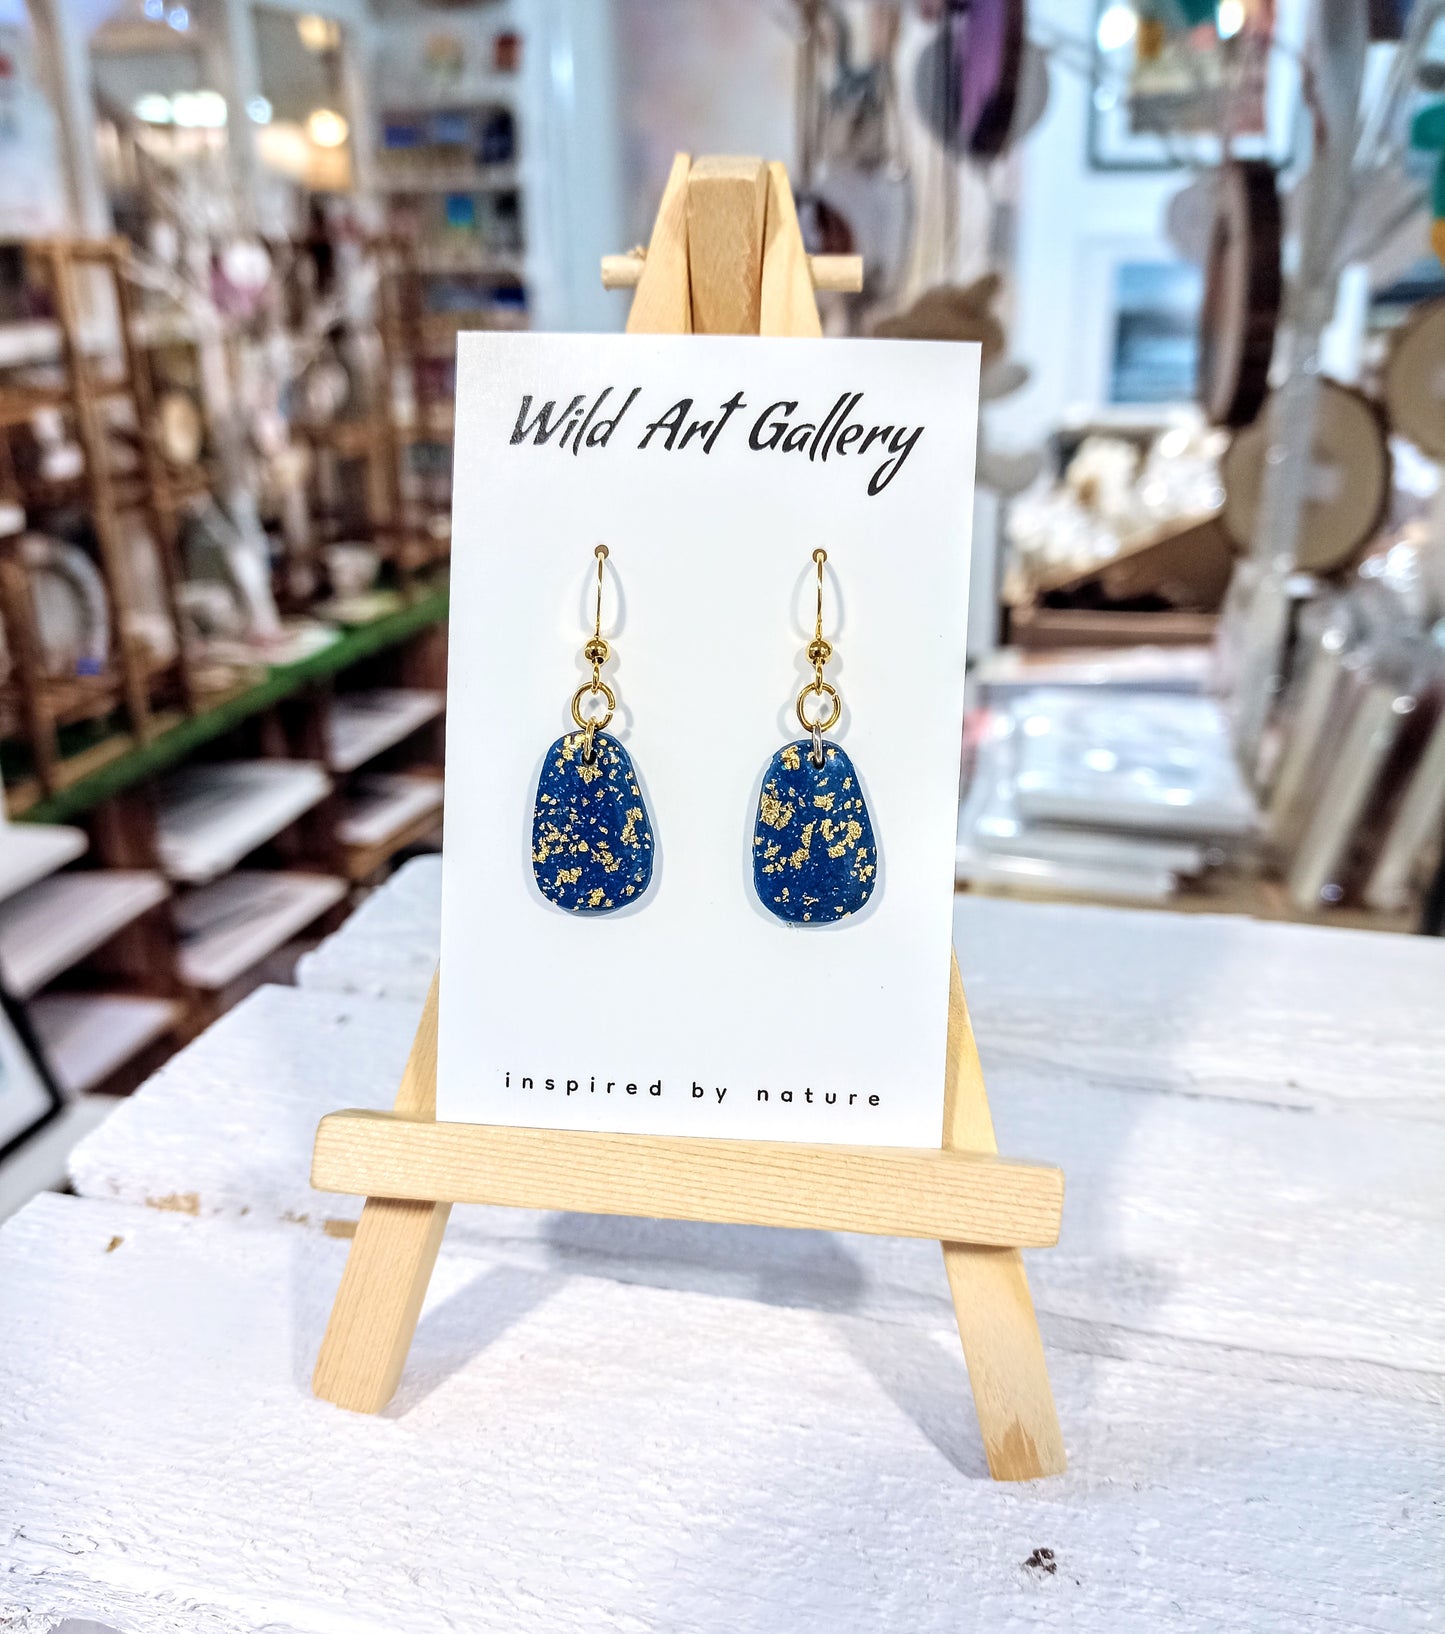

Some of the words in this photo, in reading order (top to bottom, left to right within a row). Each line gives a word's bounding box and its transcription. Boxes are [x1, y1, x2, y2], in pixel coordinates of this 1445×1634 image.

[509, 386, 642, 457] Wild
[637, 391, 748, 455] Art
[748, 392, 926, 497] Gallery
[504, 1071, 662, 1097] inspired
[691, 1080, 728, 1104] by
[757, 1086, 881, 1108] nature
